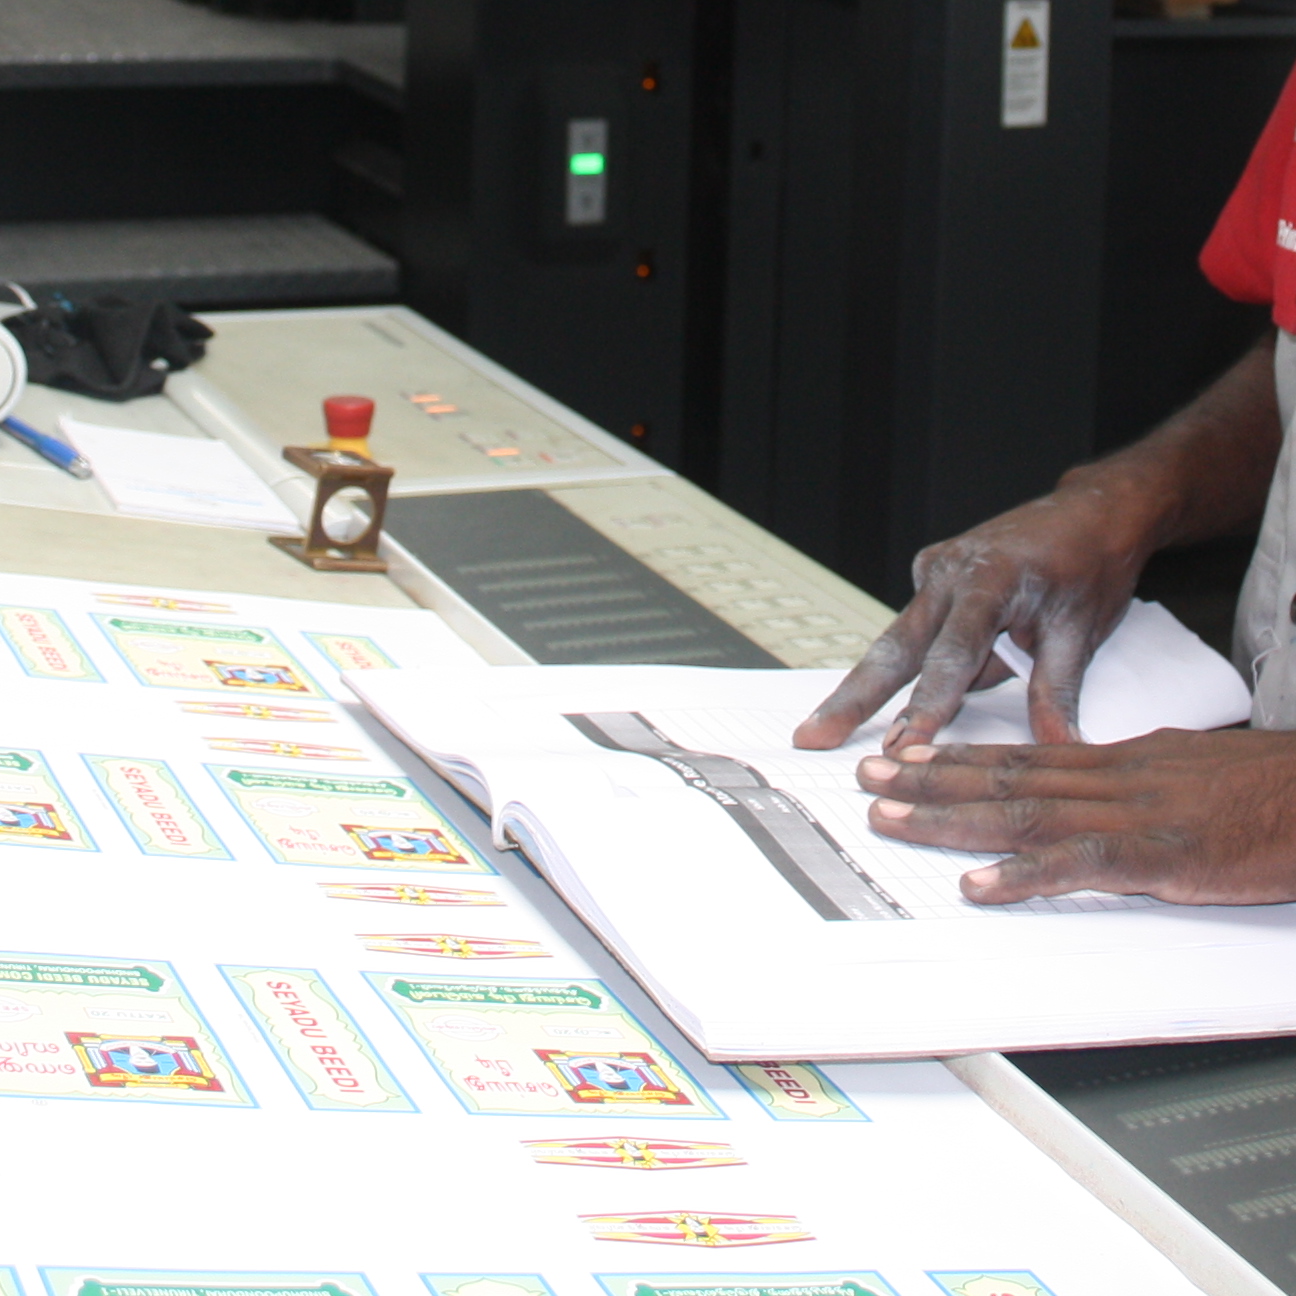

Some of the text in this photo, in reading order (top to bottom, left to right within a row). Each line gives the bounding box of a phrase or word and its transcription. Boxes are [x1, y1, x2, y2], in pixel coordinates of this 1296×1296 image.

[119, 767, 192, 846] SEYADU BEEDI
[38, 972, 86, 983] BEEDI
[87, 975, 151, 987] SEYADU
[264, 982, 367, 1094] SEYADU BEEDI
